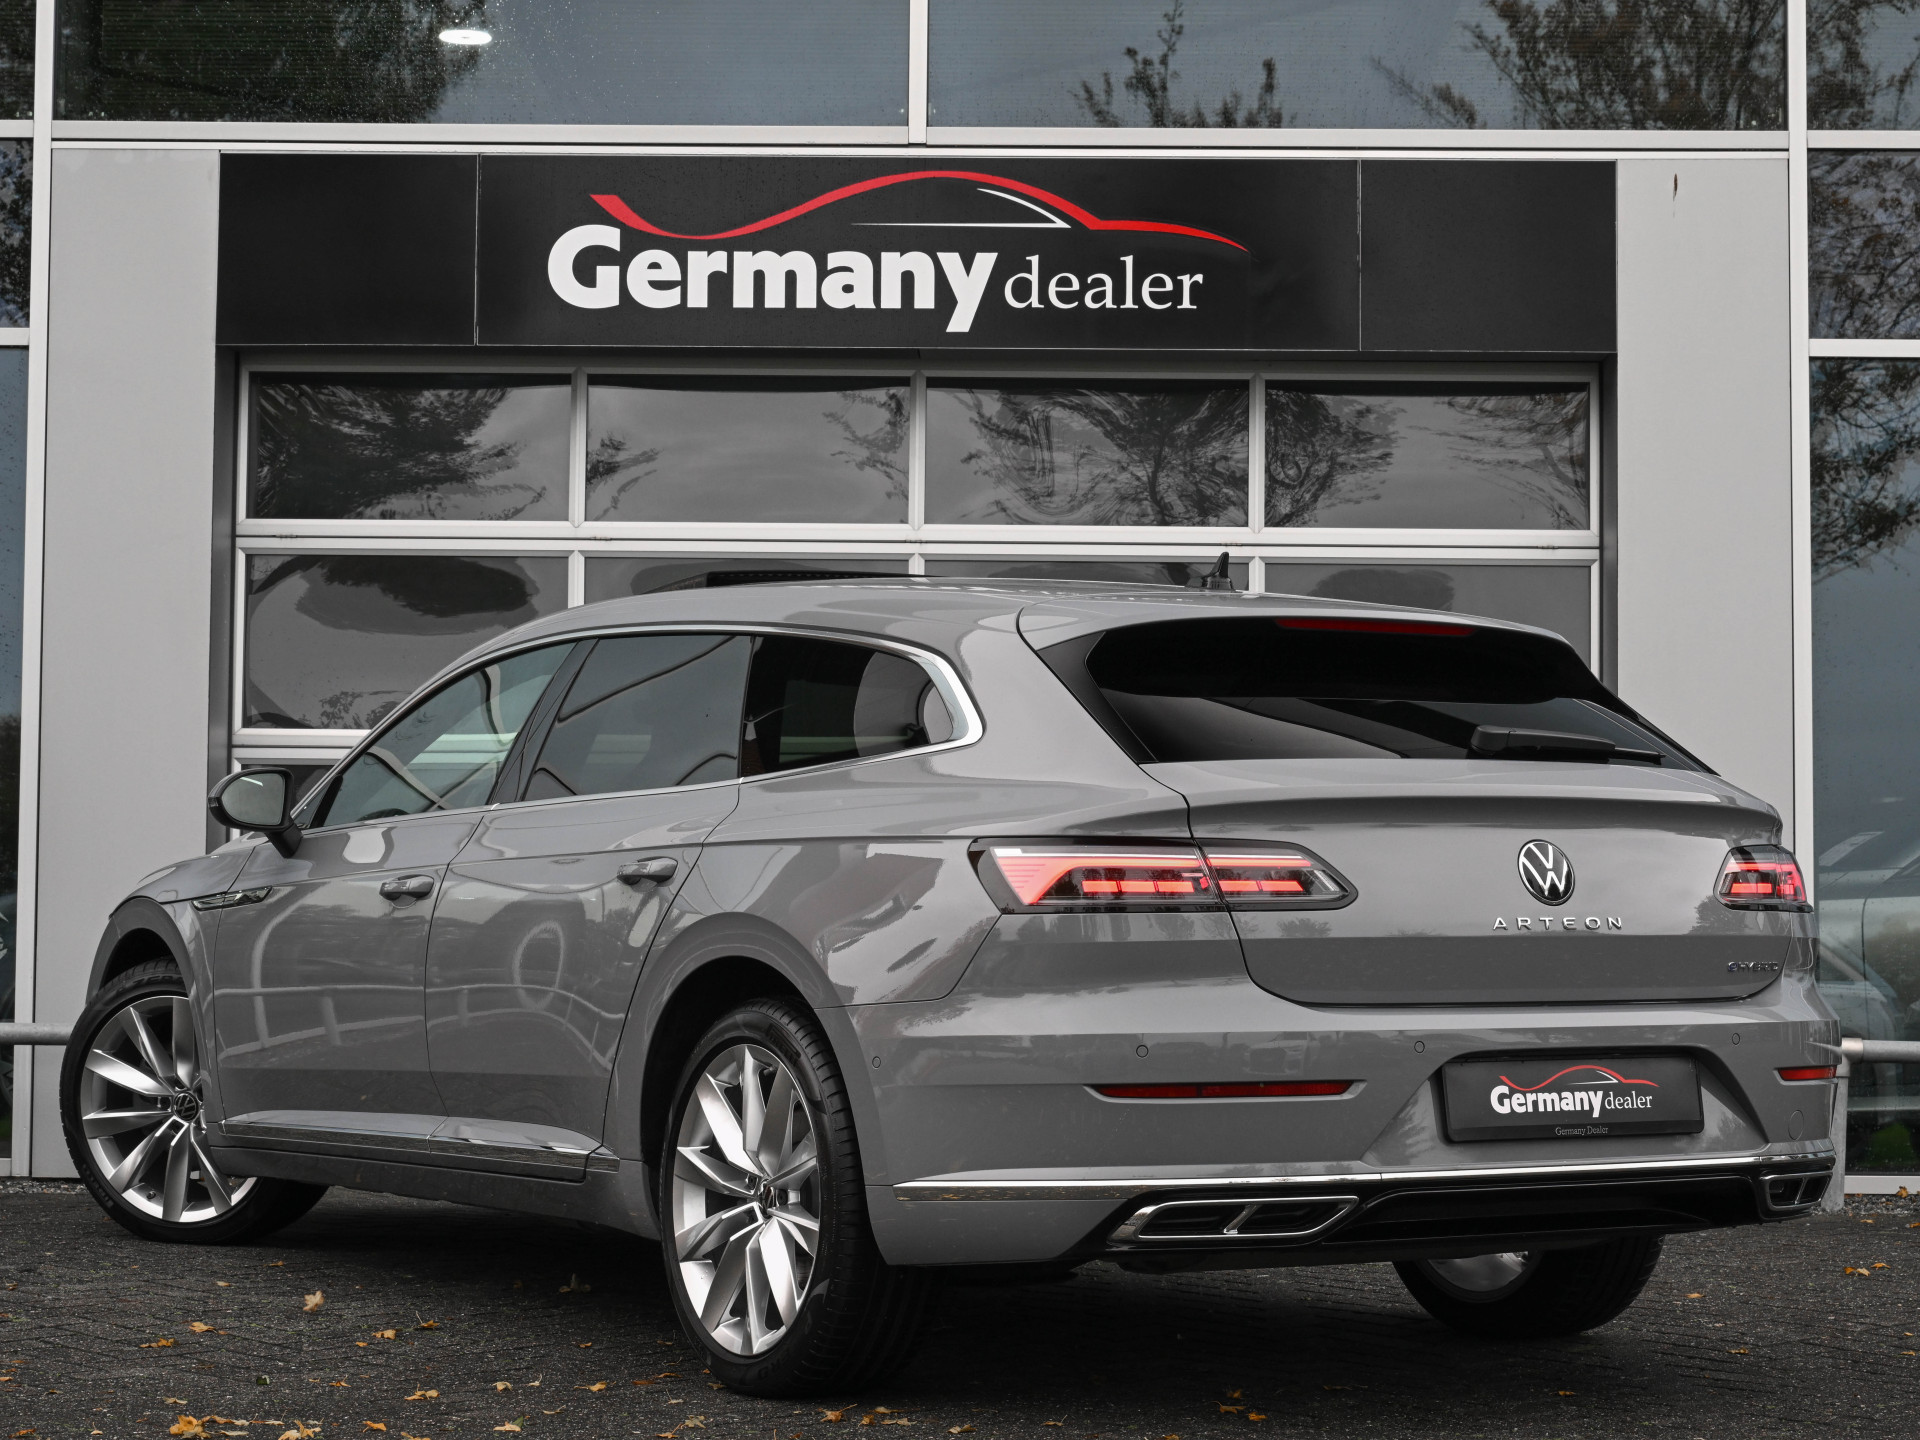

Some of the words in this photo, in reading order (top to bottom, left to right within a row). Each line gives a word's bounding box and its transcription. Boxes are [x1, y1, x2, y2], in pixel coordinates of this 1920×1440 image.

[548, 223, 998, 333] Germany
[1004, 254, 1204, 311] dealer
[1493, 916, 1623, 931] ARTEON
[1490, 1085, 1603, 1118] Germany
[1604, 1090, 1653, 1110] dealer
[1555, 1126, 1586, 1136] Germany
[1586, 1125, 1609, 1135] Dealer
